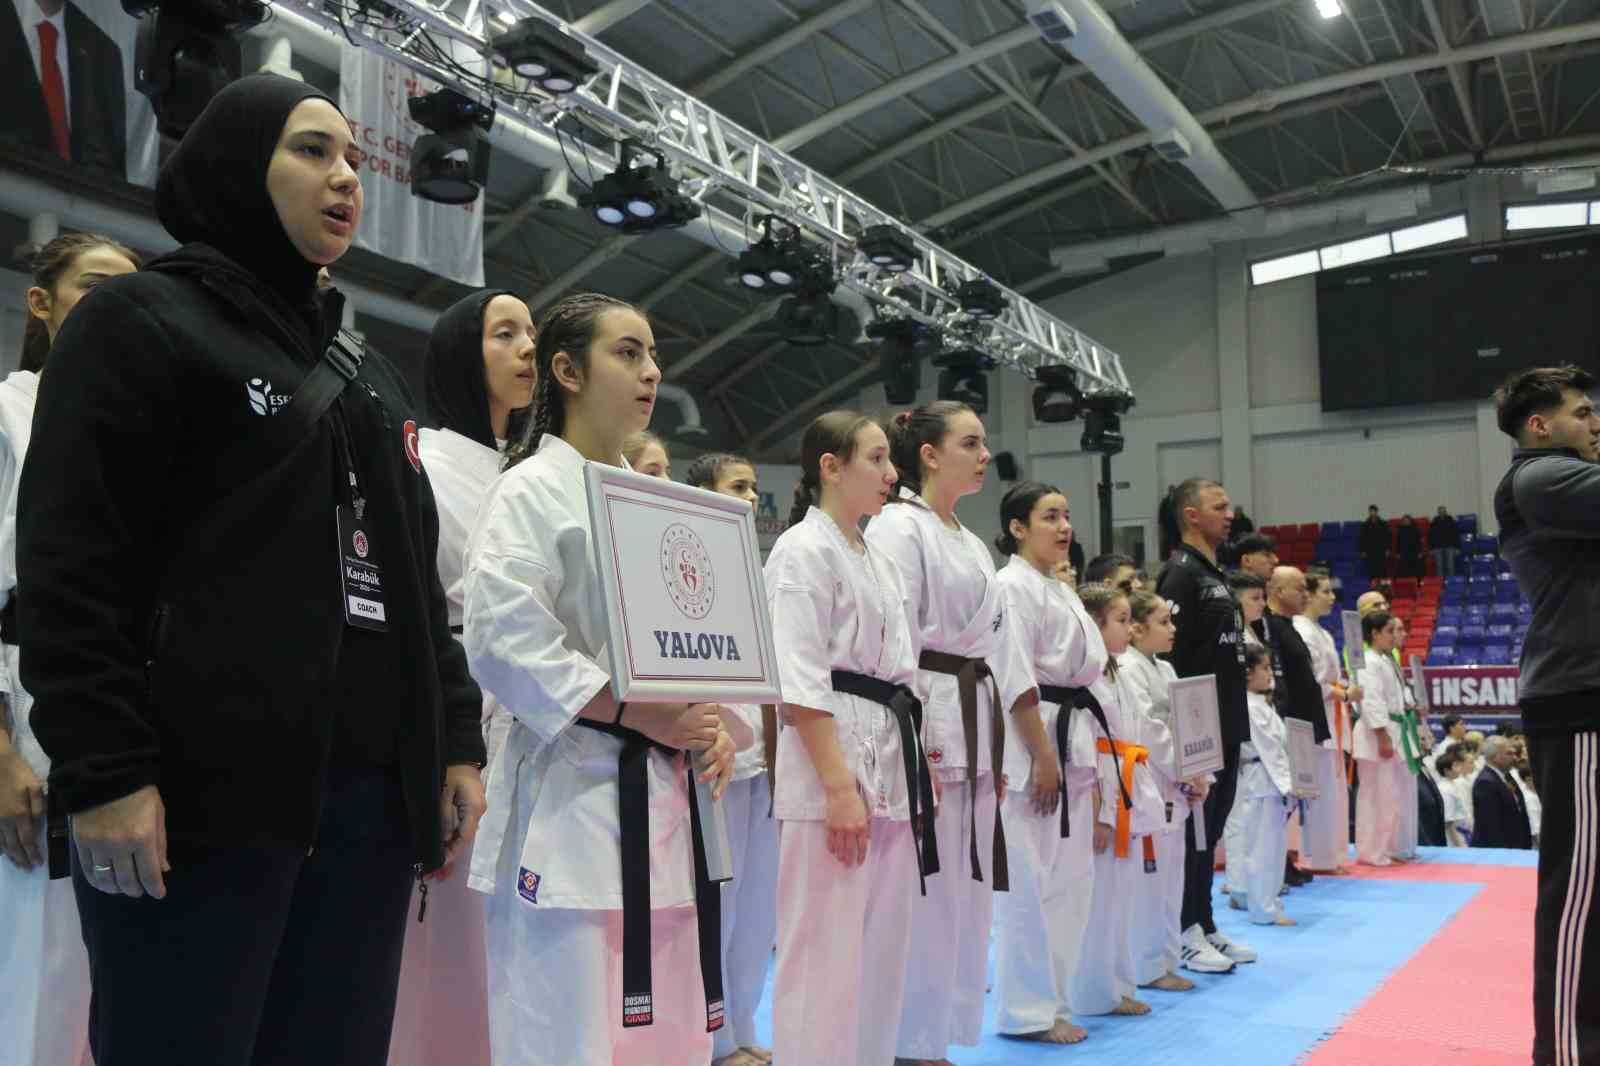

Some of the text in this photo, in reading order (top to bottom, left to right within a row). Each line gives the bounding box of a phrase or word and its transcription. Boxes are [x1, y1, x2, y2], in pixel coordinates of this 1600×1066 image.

[345, 565, 381, 586] Karabük
[357, 602, 378, 614] COACH
[653, 630, 742, 661] YALOVA
